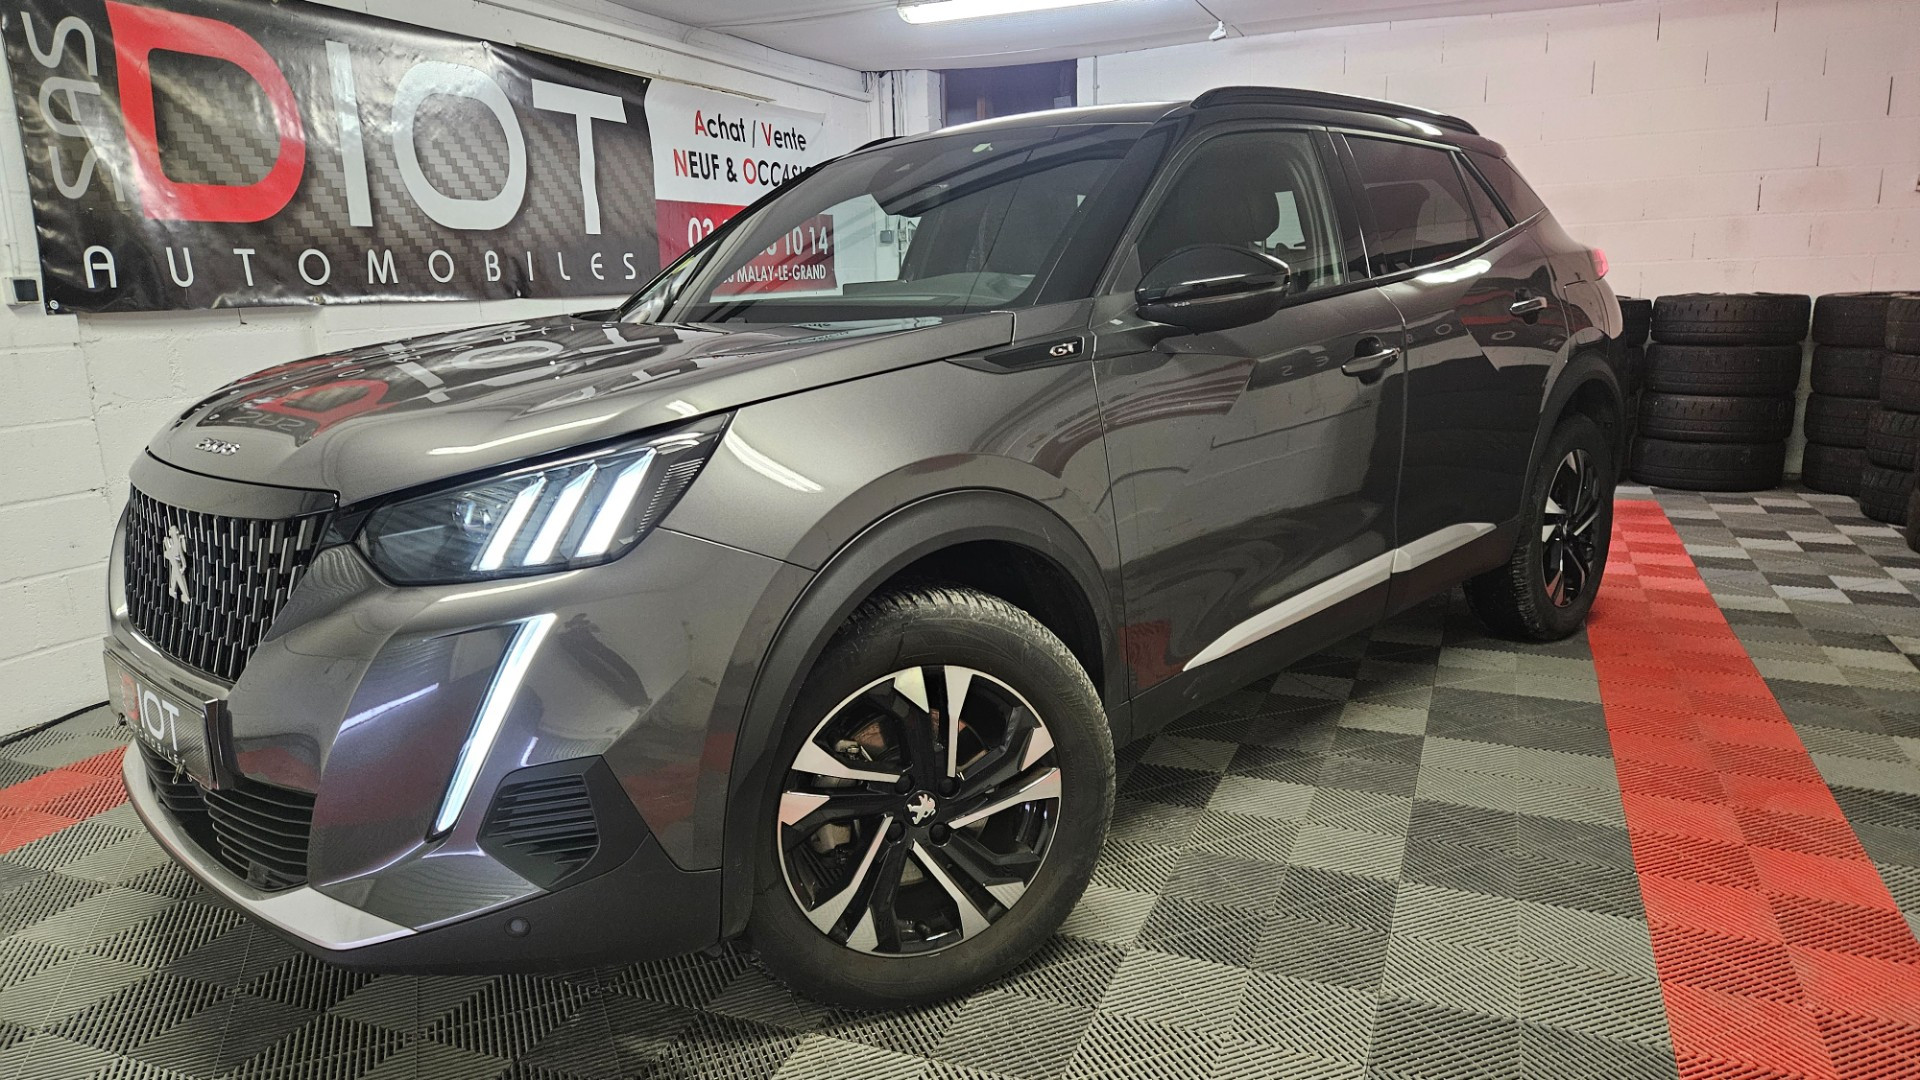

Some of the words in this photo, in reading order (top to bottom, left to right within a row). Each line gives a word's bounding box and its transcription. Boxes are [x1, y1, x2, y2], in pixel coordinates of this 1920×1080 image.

[105, 0, 628, 235] DIOT
[694, 110, 746, 143] Achat
[761, 121, 807, 151] Vente
[673, 148, 719, 180] NEUF
[726, 157, 738, 182] &
[785, 226, 804, 255] 10
[809, 226, 828, 255] 14
[83, 245, 636, 288] AUTOMOBILES
[737, 264, 827, 283] MALAY-LE-GRAND
[1050, 341, 1078, 357] GT
[121, 672, 180, 752] DIOT
